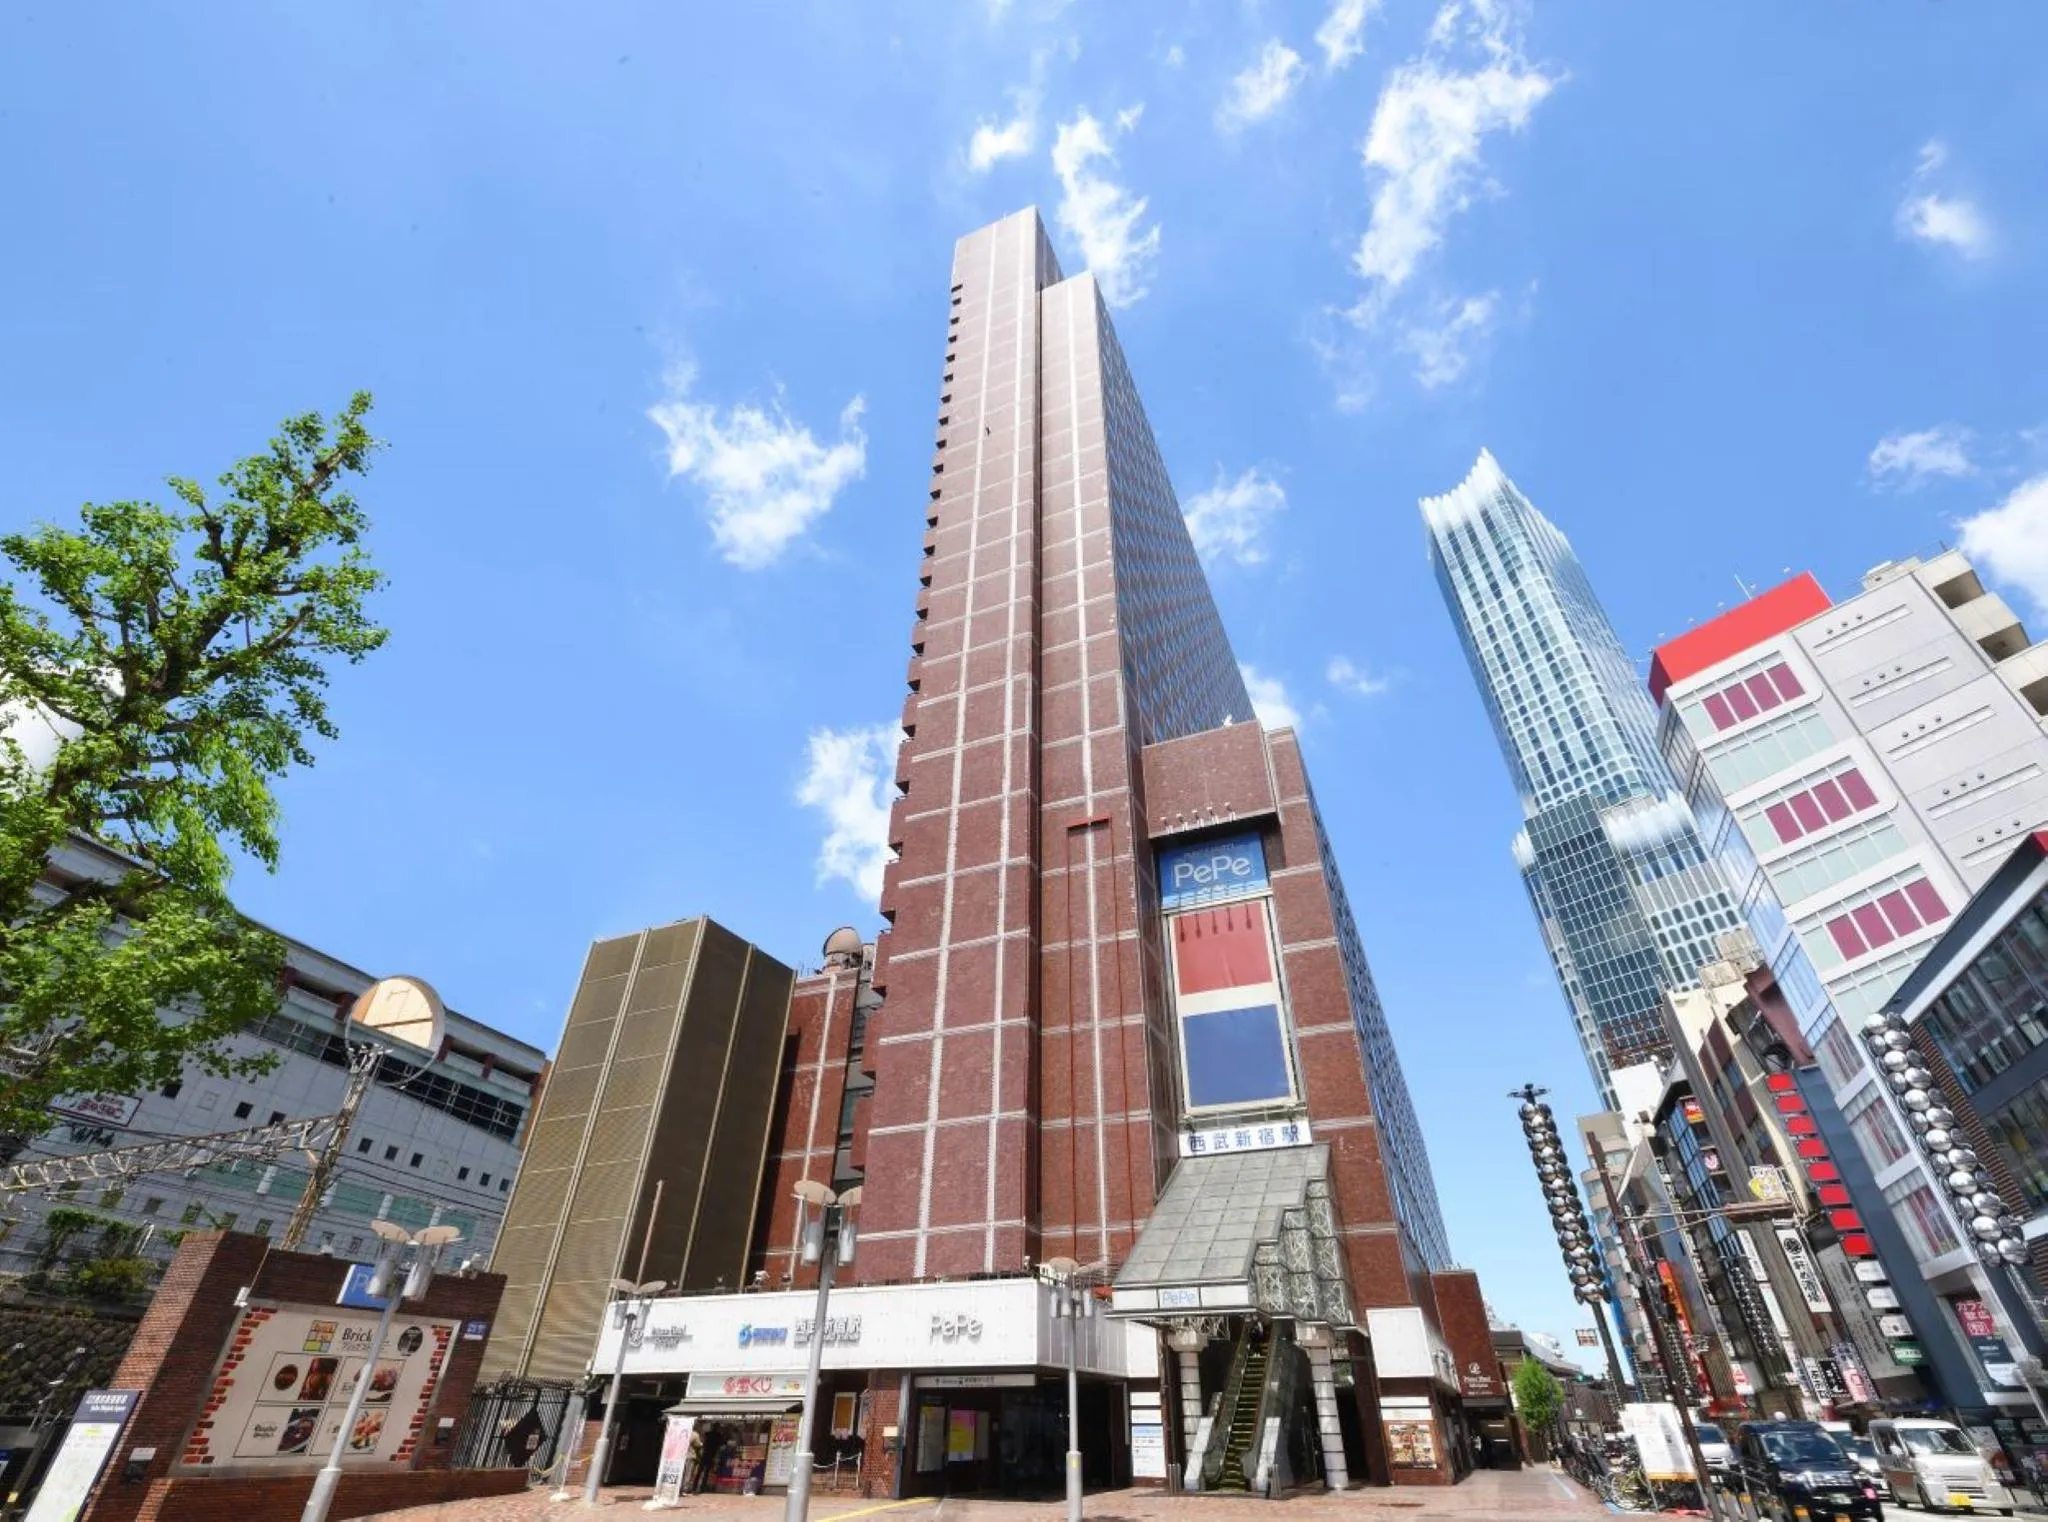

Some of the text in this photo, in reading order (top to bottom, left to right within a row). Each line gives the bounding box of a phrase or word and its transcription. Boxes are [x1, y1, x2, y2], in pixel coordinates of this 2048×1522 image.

[1174, 855, 1251, 888] PePe
[1188, 1124, 1300, 1153] 西武新宿駅
[930, 1312, 983, 1342] PePe
